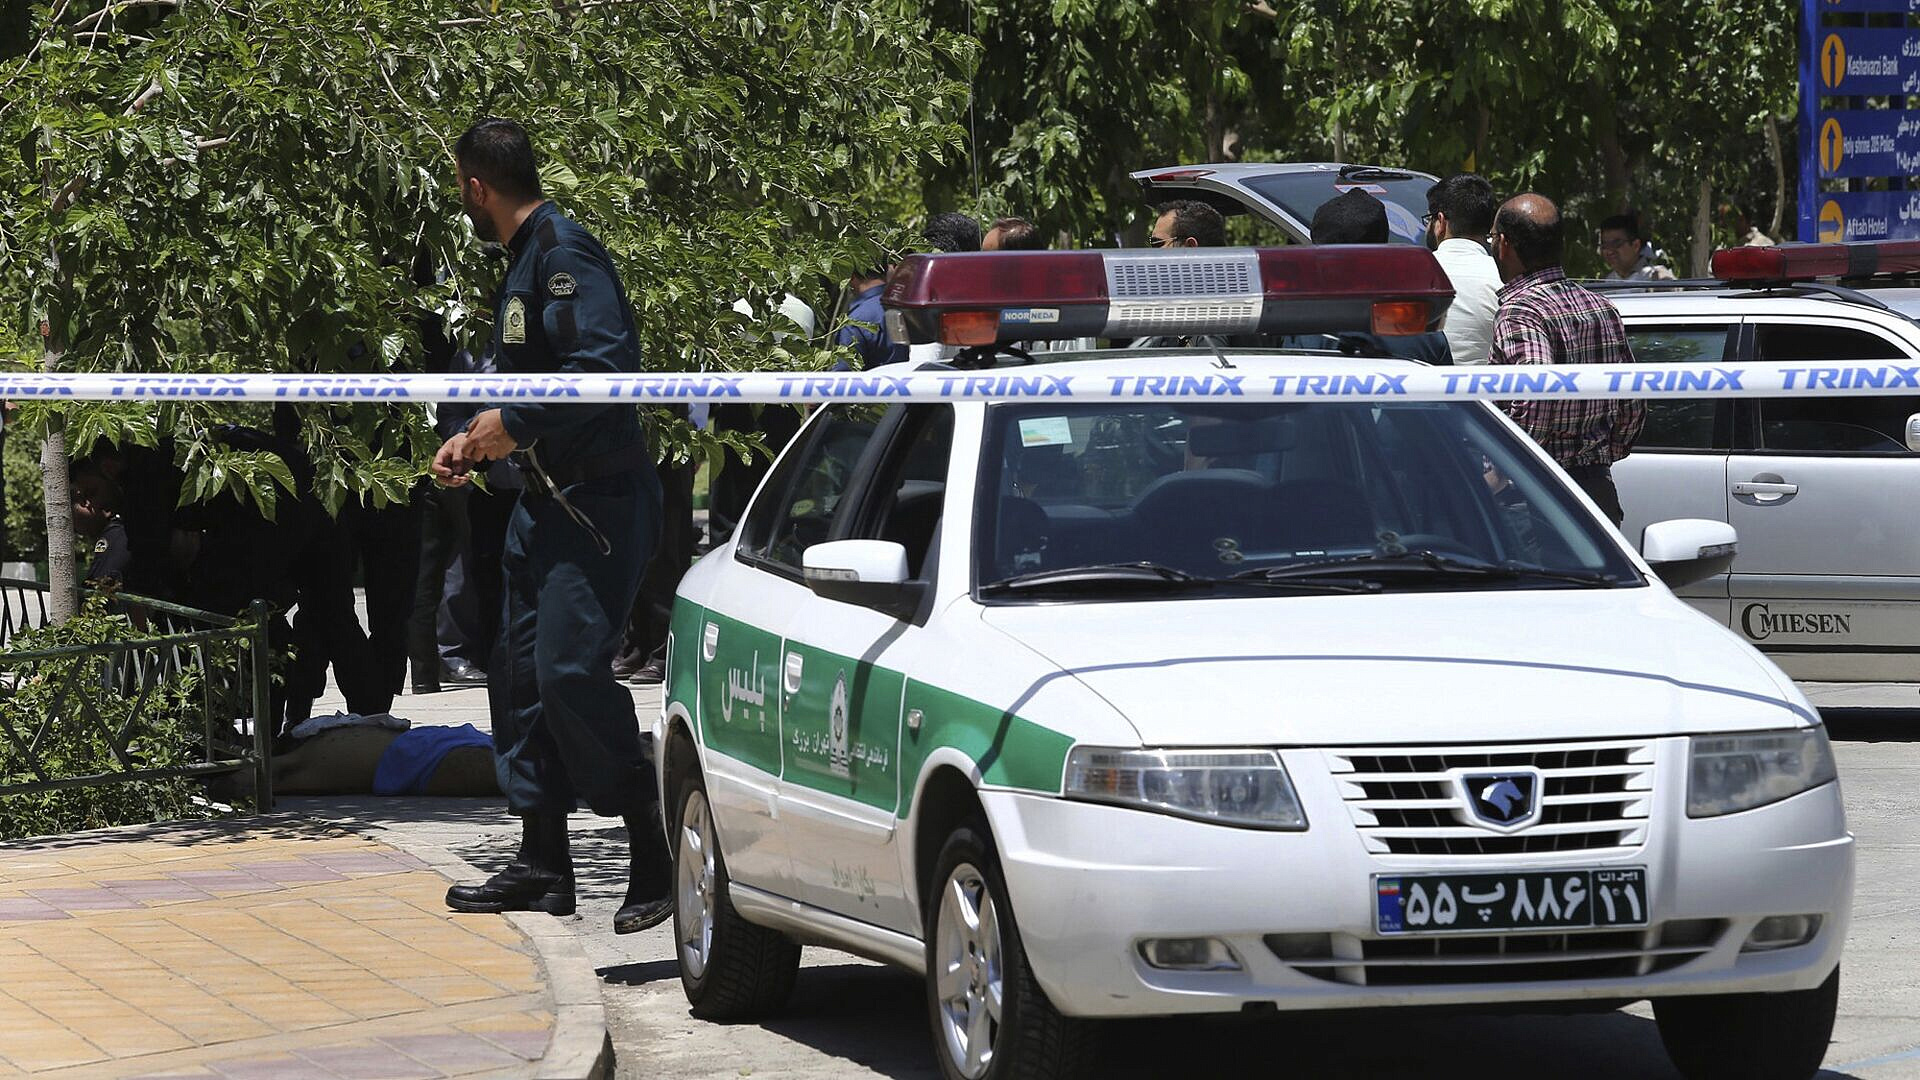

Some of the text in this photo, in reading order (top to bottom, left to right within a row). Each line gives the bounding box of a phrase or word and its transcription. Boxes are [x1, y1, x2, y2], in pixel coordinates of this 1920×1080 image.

[1847, 55, 1898, 76] Keshavarzi Bank
[1847, 216, 1887, 236] Aftab Hotel
[1004, 312, 1030, 320] NOOR
[110, 377, 250, 396] TRINX
[272, 377, 413, 397] TRINX
[443, 377, 583, 397] TRINX
[605, 377, 742, 397] TRINX
[776, 376, 911, 397] TRINX
[936, 375, 1075, 396] TRINX
[1107, 375, 1247, 396] TRINX
[1269, 374, 1408, 395] TRINX
[1441, 371, 1580, 393] TRINX
[1604, 368, 1745, 391] TRINX
[1778, 365, 1920, 389] TRINX
[722, 650, 764, 732] پلیس
